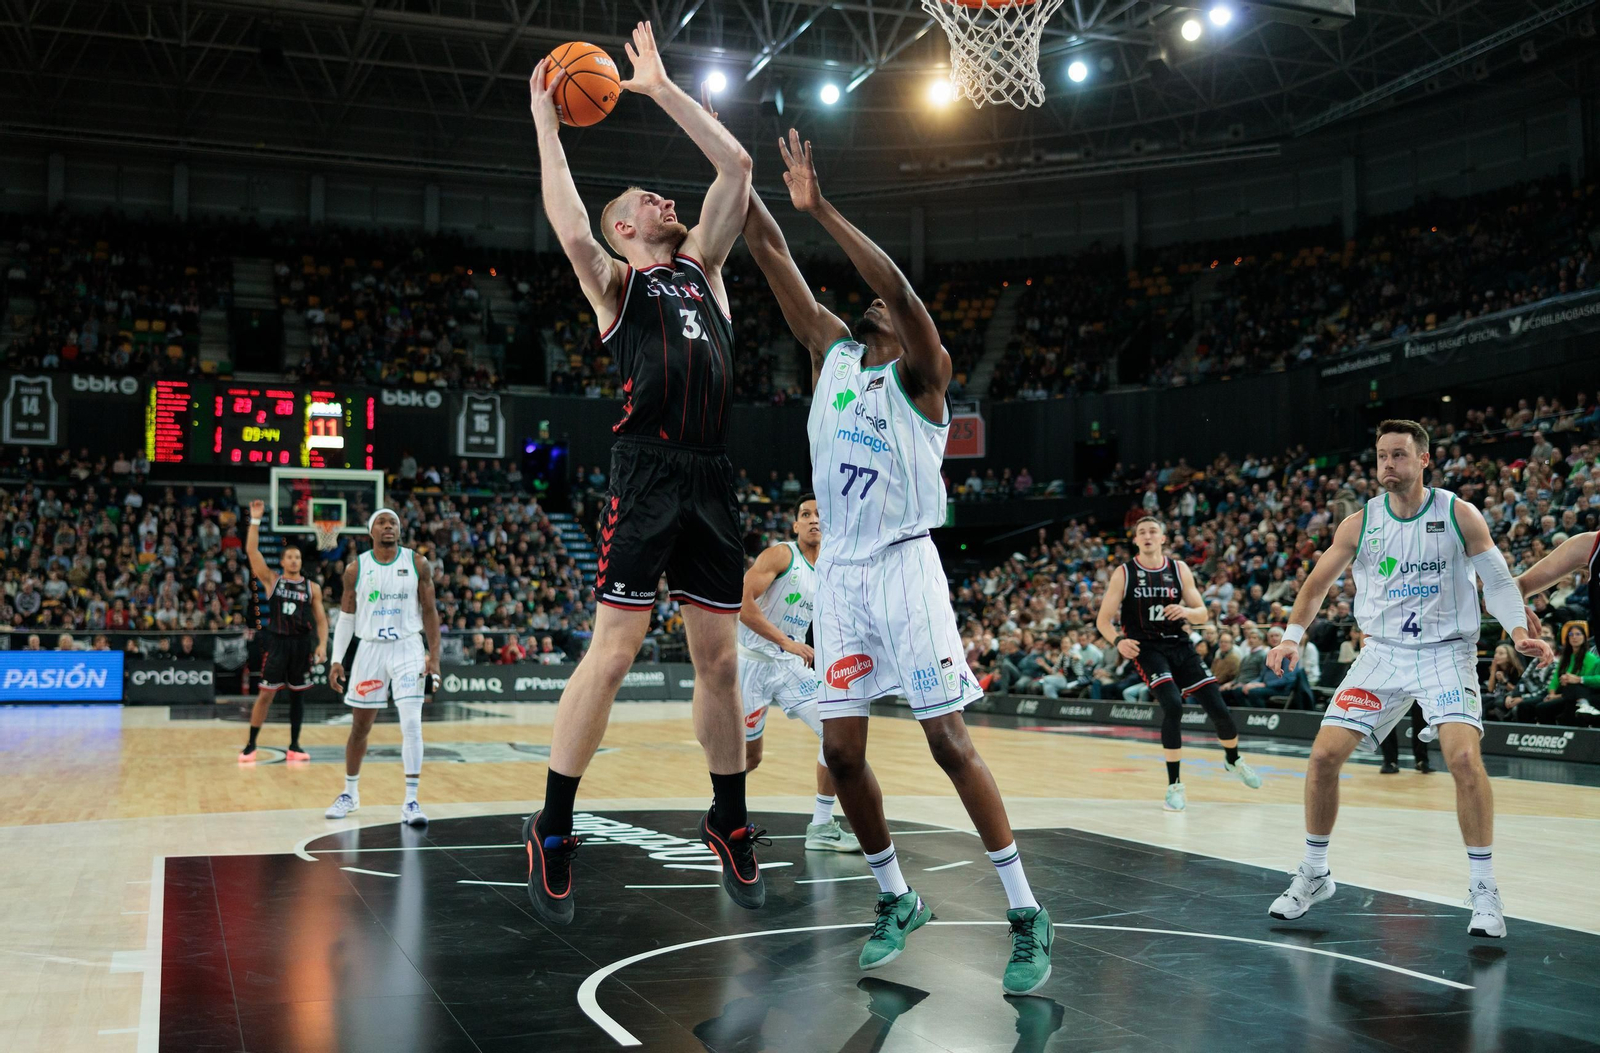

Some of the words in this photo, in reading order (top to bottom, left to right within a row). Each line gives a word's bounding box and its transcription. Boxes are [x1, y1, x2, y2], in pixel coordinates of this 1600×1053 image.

[679, 308, 709, 342] 3
[1468, 328, 1500, 345] OFICIAL
[72, 373, 119, 393] bbk
[22, 395, 40, 416] 14
[381, 388, 424, 407] bbk
[952, 421, 974, 440] 25
[840, 462, 879, 500] 77
[1399, 559, 1447, 574] Unicaja
[1133, 586, 1179, 599] surne
[1388, 583, 1439, 599] málaga
[282, 601, 297, 615] 19
[1148, 604, 1166, 621] 12
[1401, 611, 1422, 637] 4
[3, 662, 108, 689] PASIÓN
[132, 666, 214, 685] endesa
[829, 657, 872, 686] famadesa
[461, 677, 504, 693] IMQ
[532, 676, 567, 691] Petro
[1336, 689, 1380, 709] famadesa
[1059, 705, 1094, 716] NISSAN
[1247, 713, 1269, 727] bbk
[1506, 733, 1520, 746] EL
[1520, 734, 1568, 749] CORREO
